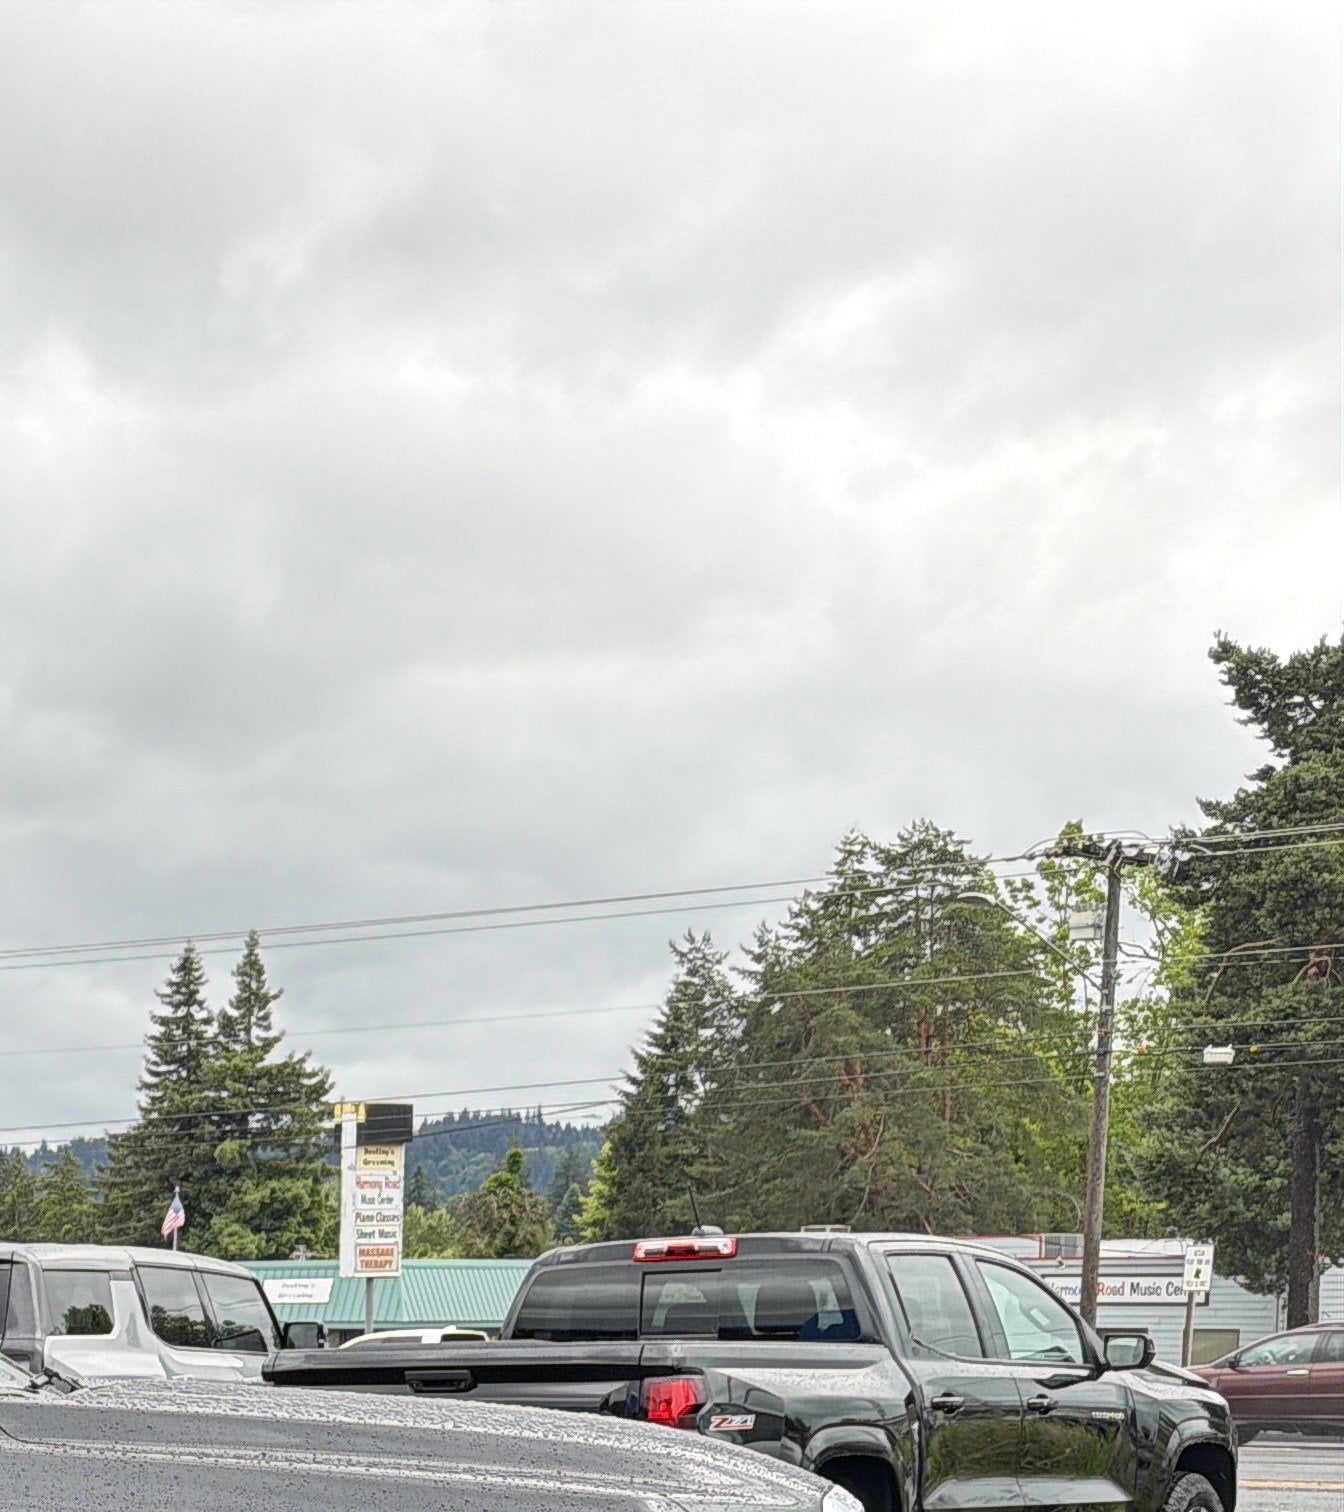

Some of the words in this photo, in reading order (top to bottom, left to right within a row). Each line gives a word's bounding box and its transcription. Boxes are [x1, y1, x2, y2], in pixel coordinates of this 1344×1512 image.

[355, 1212, 374, 1223] Piano
[359, 1248, 394, 1257] MASSAGE
[360, 1260, 393, 1269] THERAPY
[1097, 1281, 1126, 1297] Road
[1129, 1281, 1163, 1297] Music
[709, 1414, 756, 1431] Z71
